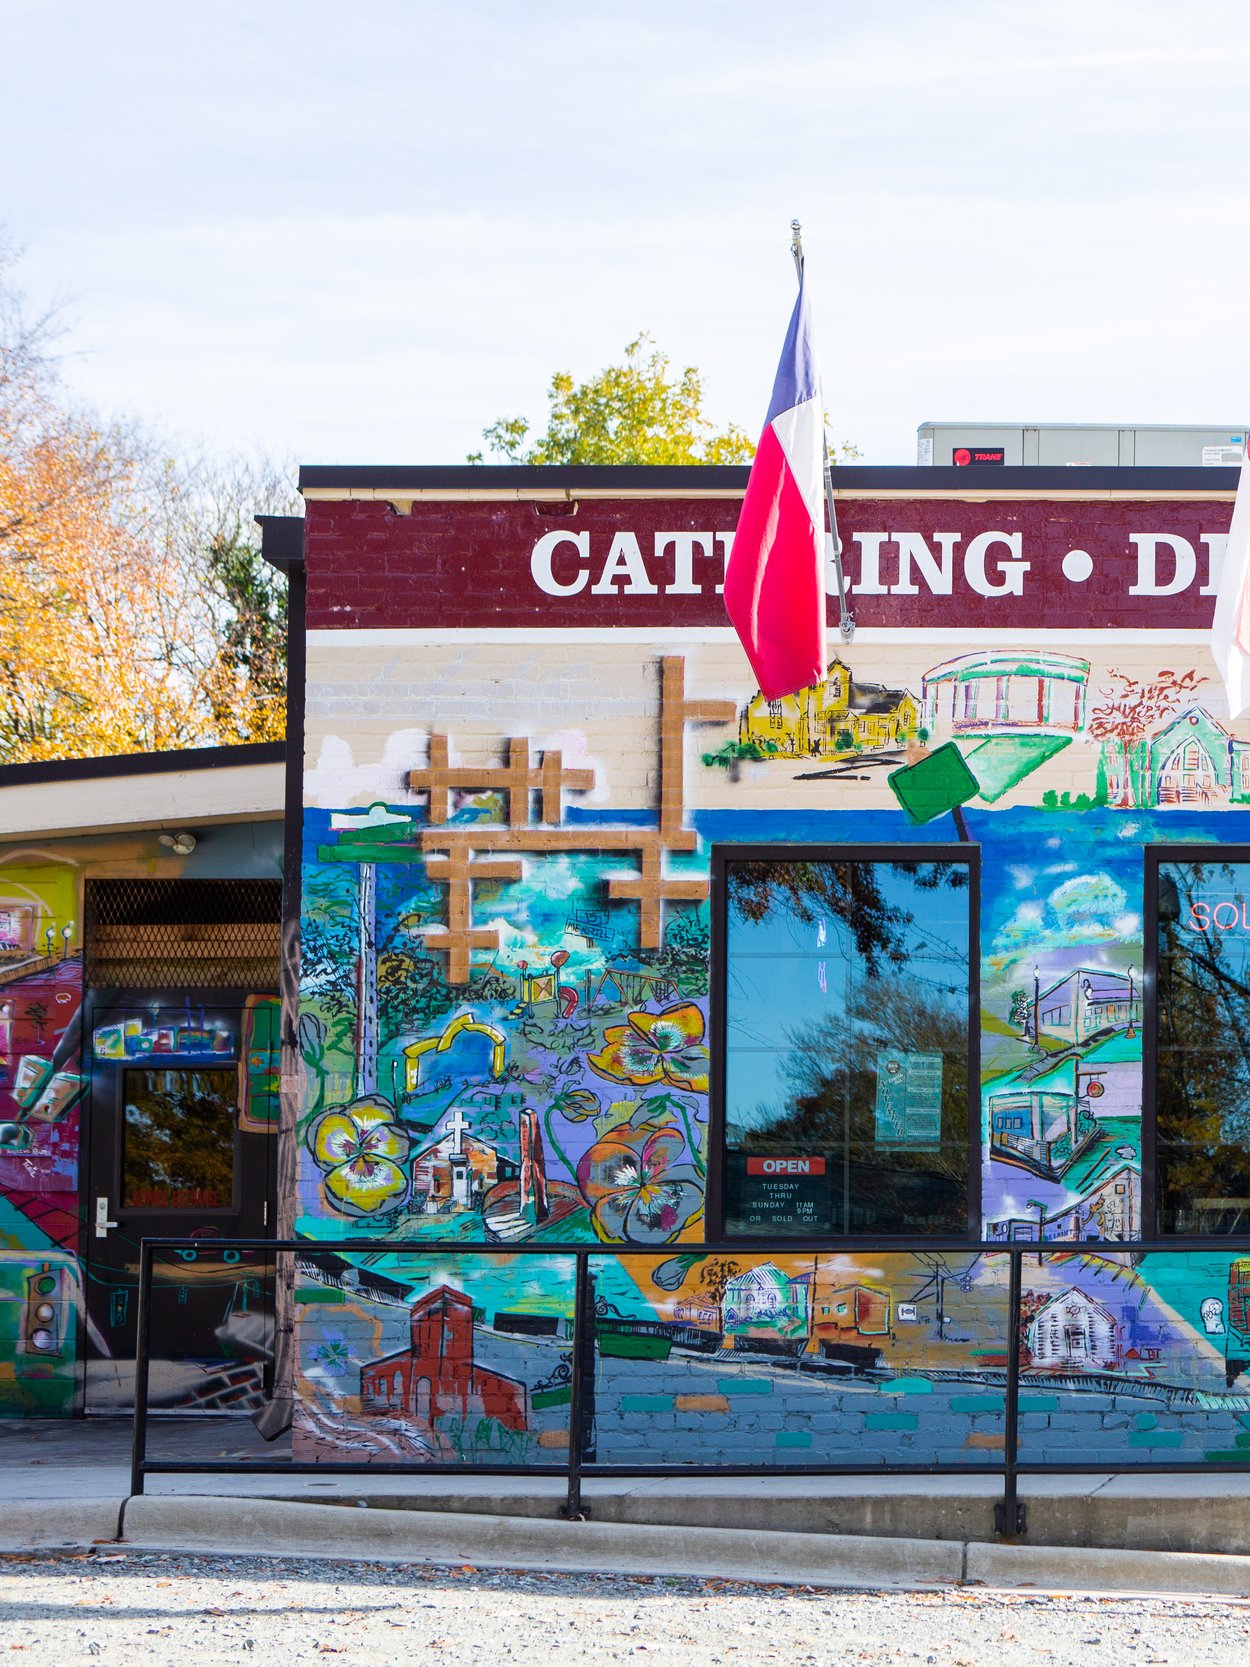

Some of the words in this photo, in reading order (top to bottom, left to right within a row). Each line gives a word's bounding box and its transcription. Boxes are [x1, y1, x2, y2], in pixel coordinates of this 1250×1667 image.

[974, 453, 1003, 461] TRANE
[529, 529, 1032, 598] CATING
[762, 1160, 810, 1173] OPEN
